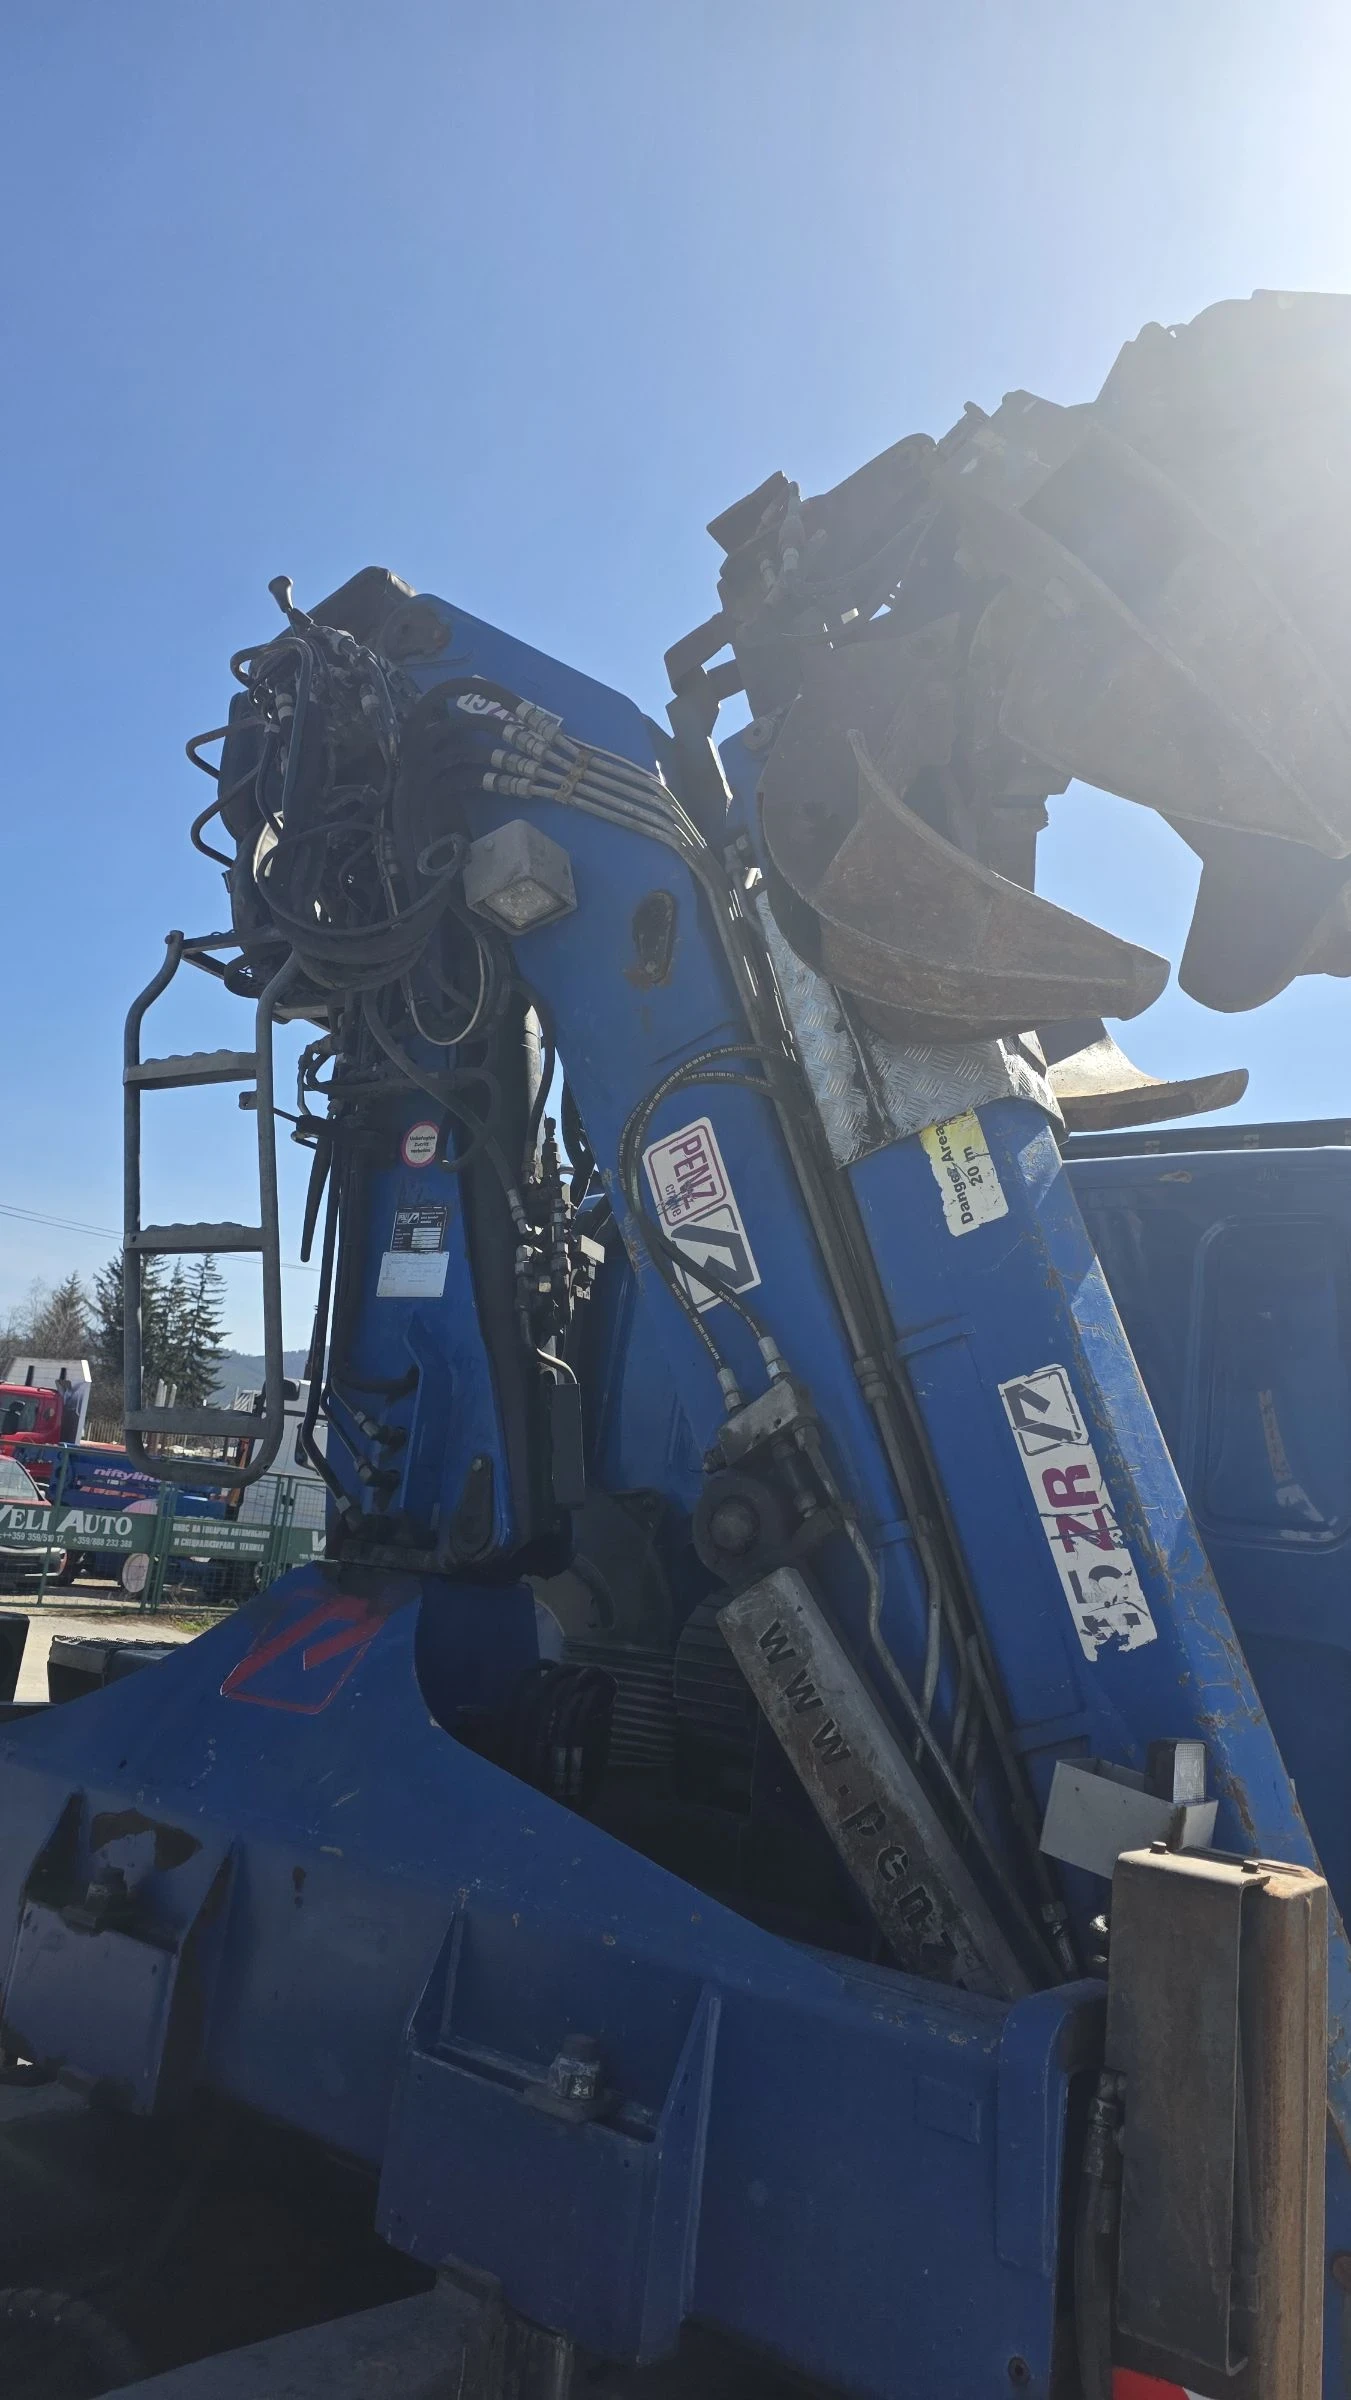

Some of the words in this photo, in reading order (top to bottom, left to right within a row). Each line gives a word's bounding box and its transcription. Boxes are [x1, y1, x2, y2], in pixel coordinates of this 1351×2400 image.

[935, 1124, 954, 1163] Area
[962, 1145, 977, 1163] m
[668, 1134, 718, 1211] PENZ
[966, 1165, 984, 1187] 20
[665, 1183, 682, 1217] crae
[55, 1509, 133, 1536] AUTO
